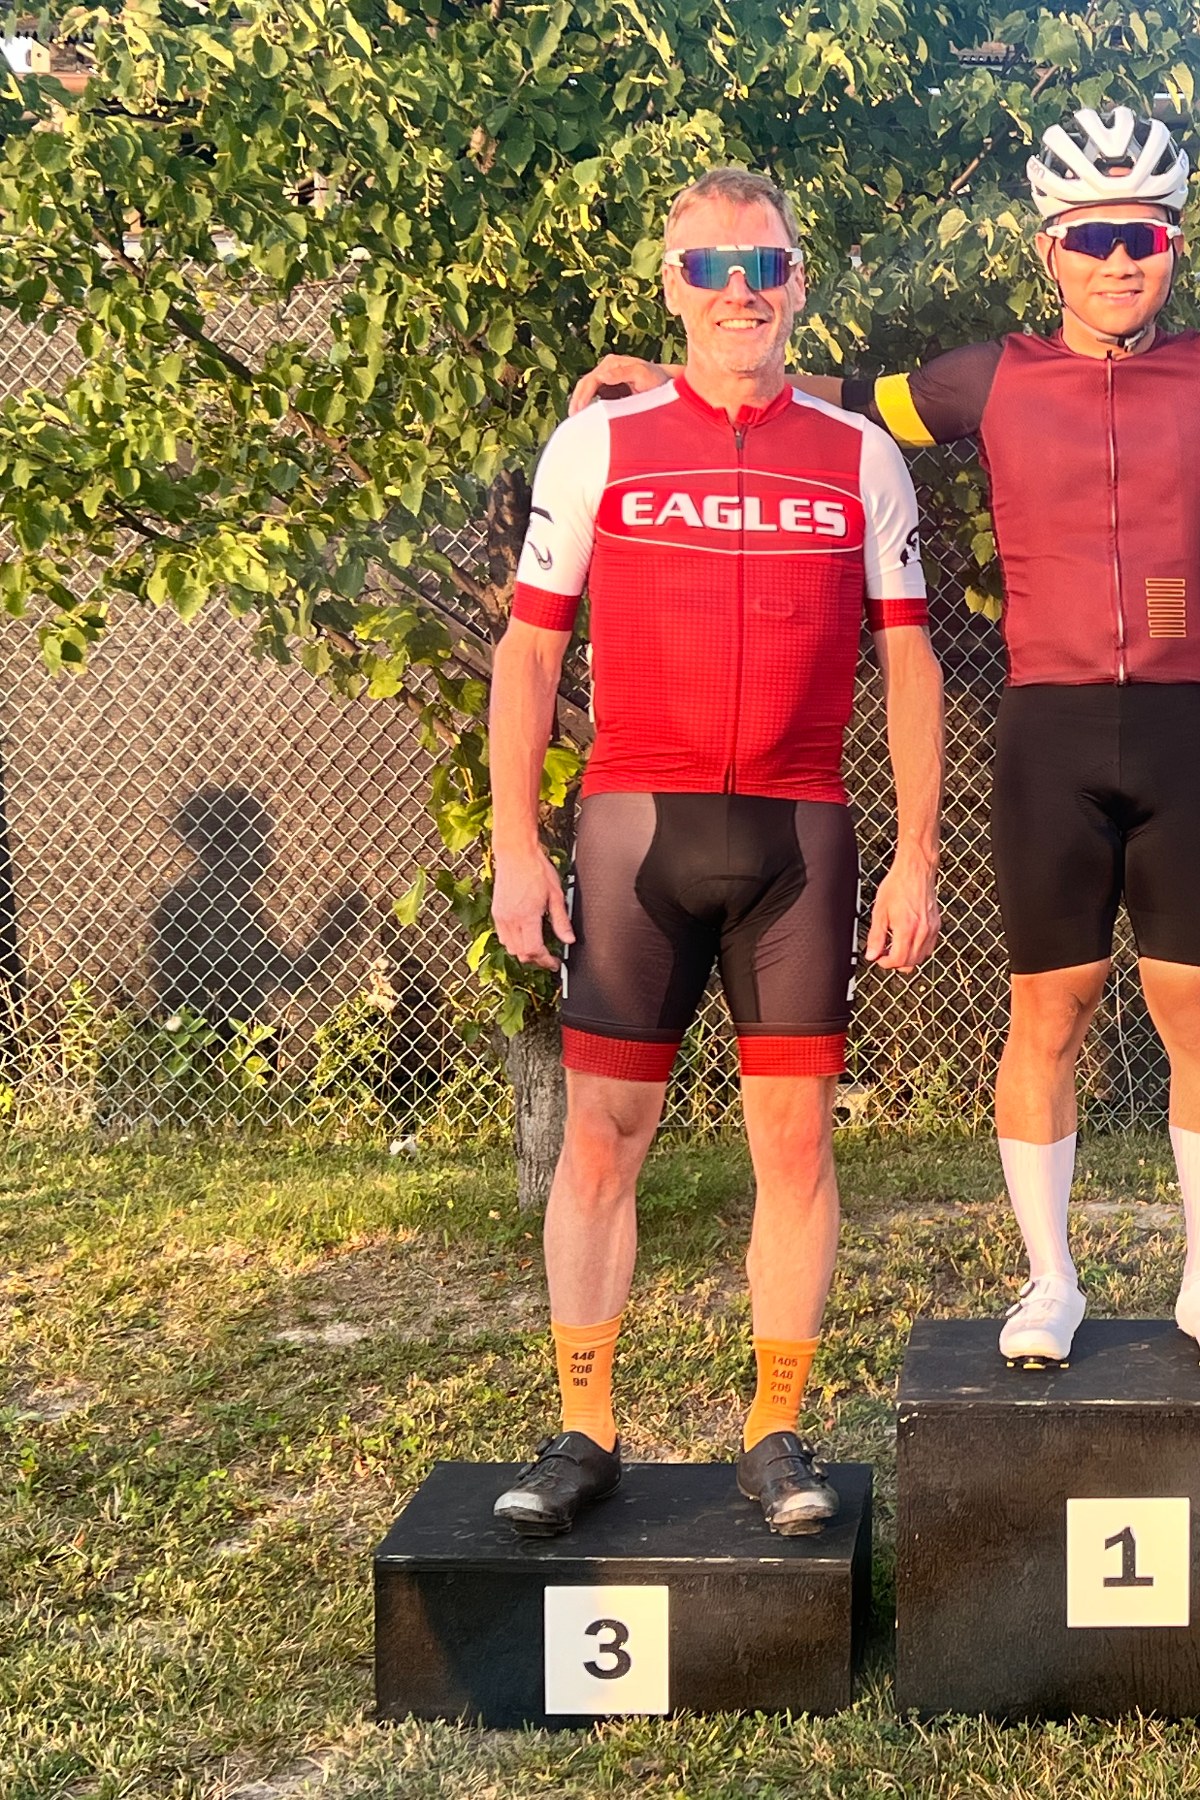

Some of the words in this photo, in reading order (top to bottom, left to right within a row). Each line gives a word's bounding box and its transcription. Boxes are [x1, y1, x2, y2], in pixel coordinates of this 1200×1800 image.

[621, 491, 848, 538] EAGLES
[1103, 1526, 1154, 1588] 1
[583, 1618, 632, 1680] 3
